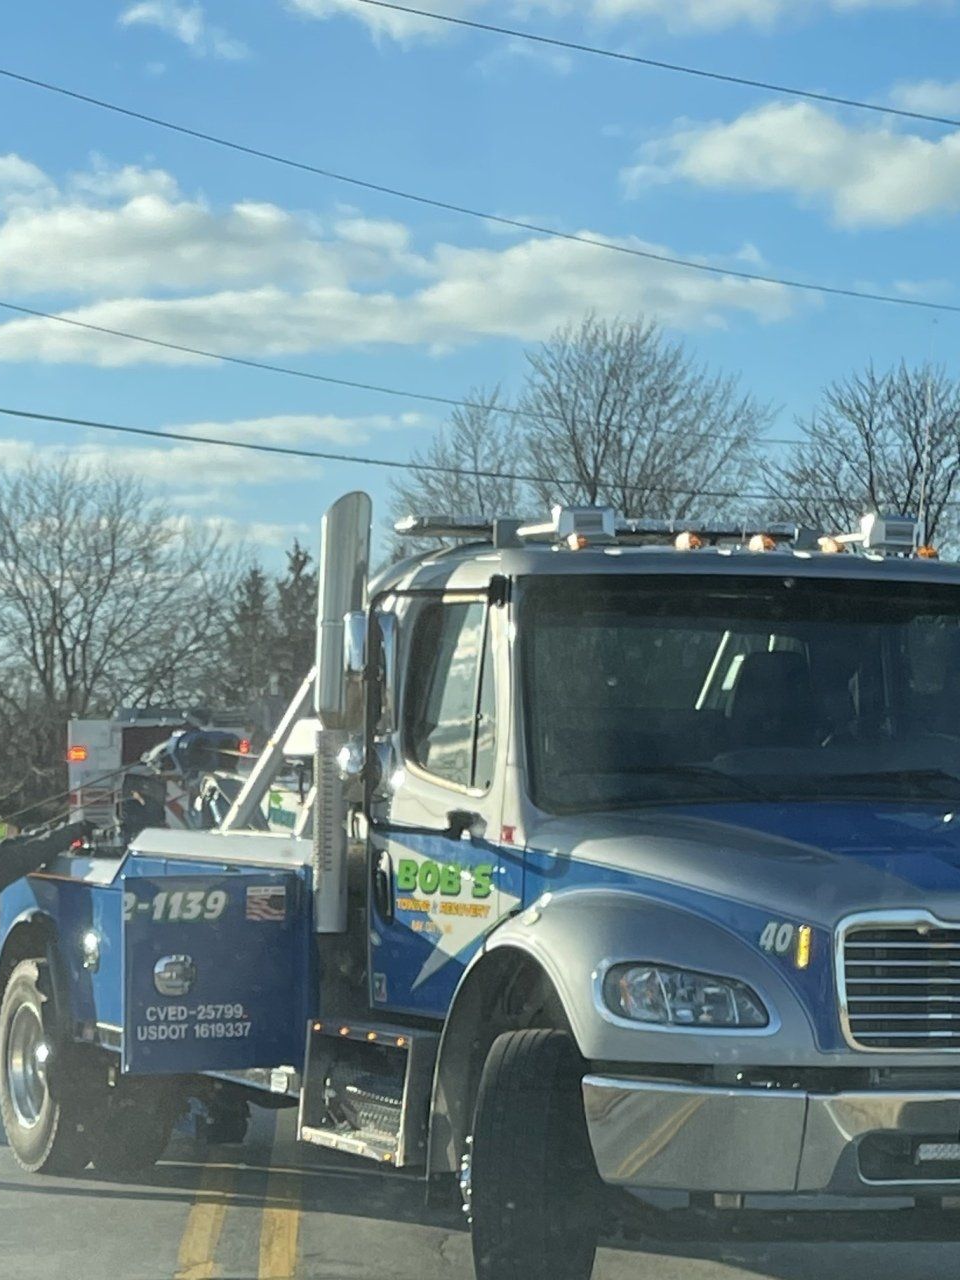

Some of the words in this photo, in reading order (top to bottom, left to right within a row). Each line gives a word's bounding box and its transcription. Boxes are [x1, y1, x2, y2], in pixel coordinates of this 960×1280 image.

[759, 921, 794, 953] 40
[137, 1023, 189, 1041] USDOT
[193, 1021, 252, 1039] 1619337
